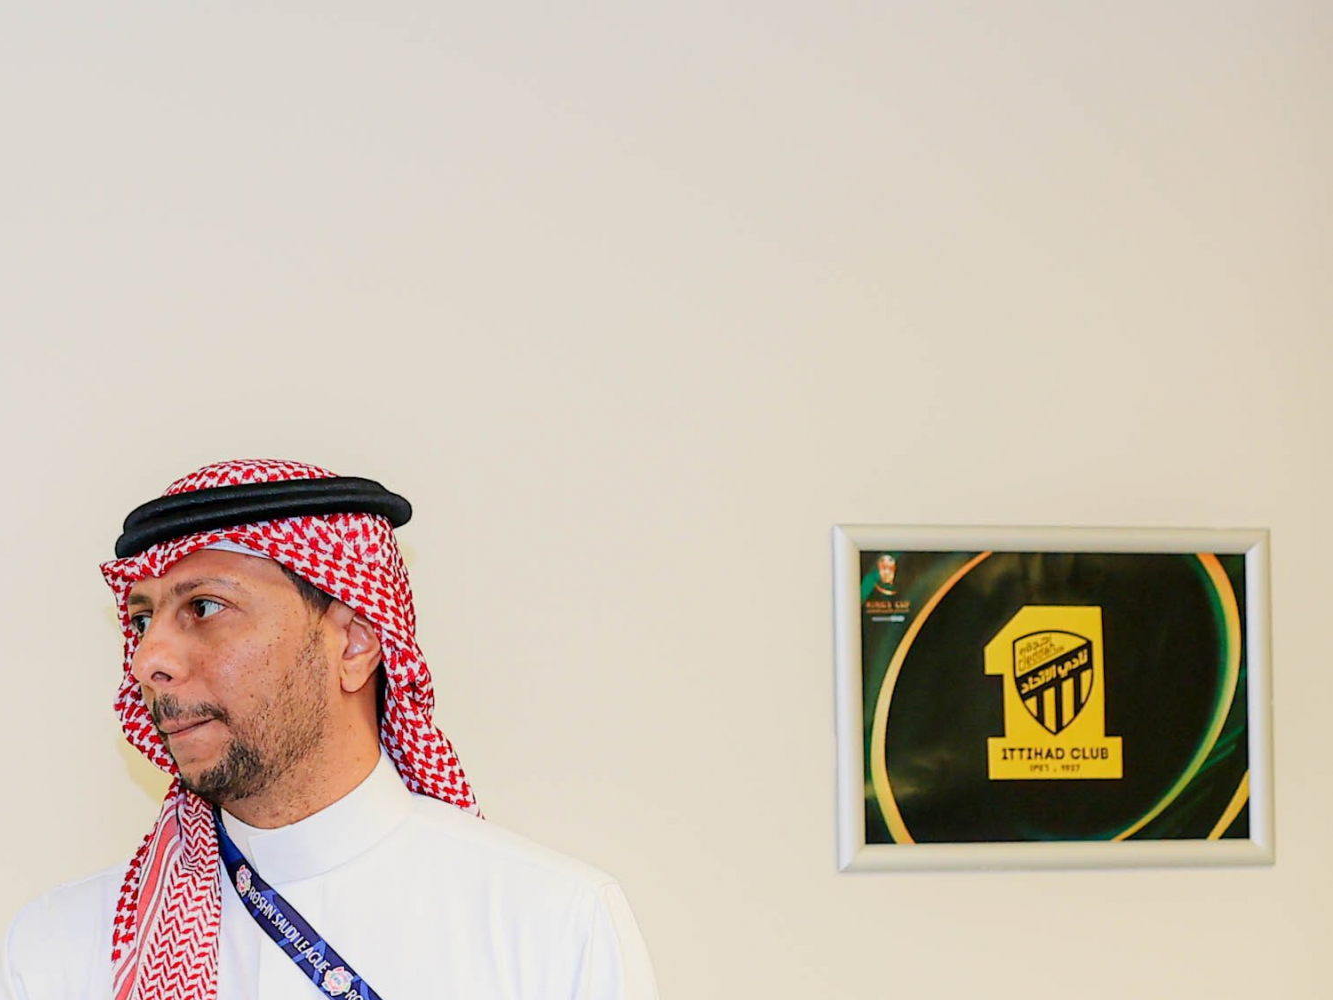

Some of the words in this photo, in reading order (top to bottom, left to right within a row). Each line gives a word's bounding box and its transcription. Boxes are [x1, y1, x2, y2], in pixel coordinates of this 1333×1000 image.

[1002, 748, 1065, 760] ITTIHAD
[1070, 747, 1109, 760] CLUB
[247, 886, 277, 919] ROSHN
[271, 913, 301, 942] SAUDI
[293, 936, 331, 974] LEAGUE
